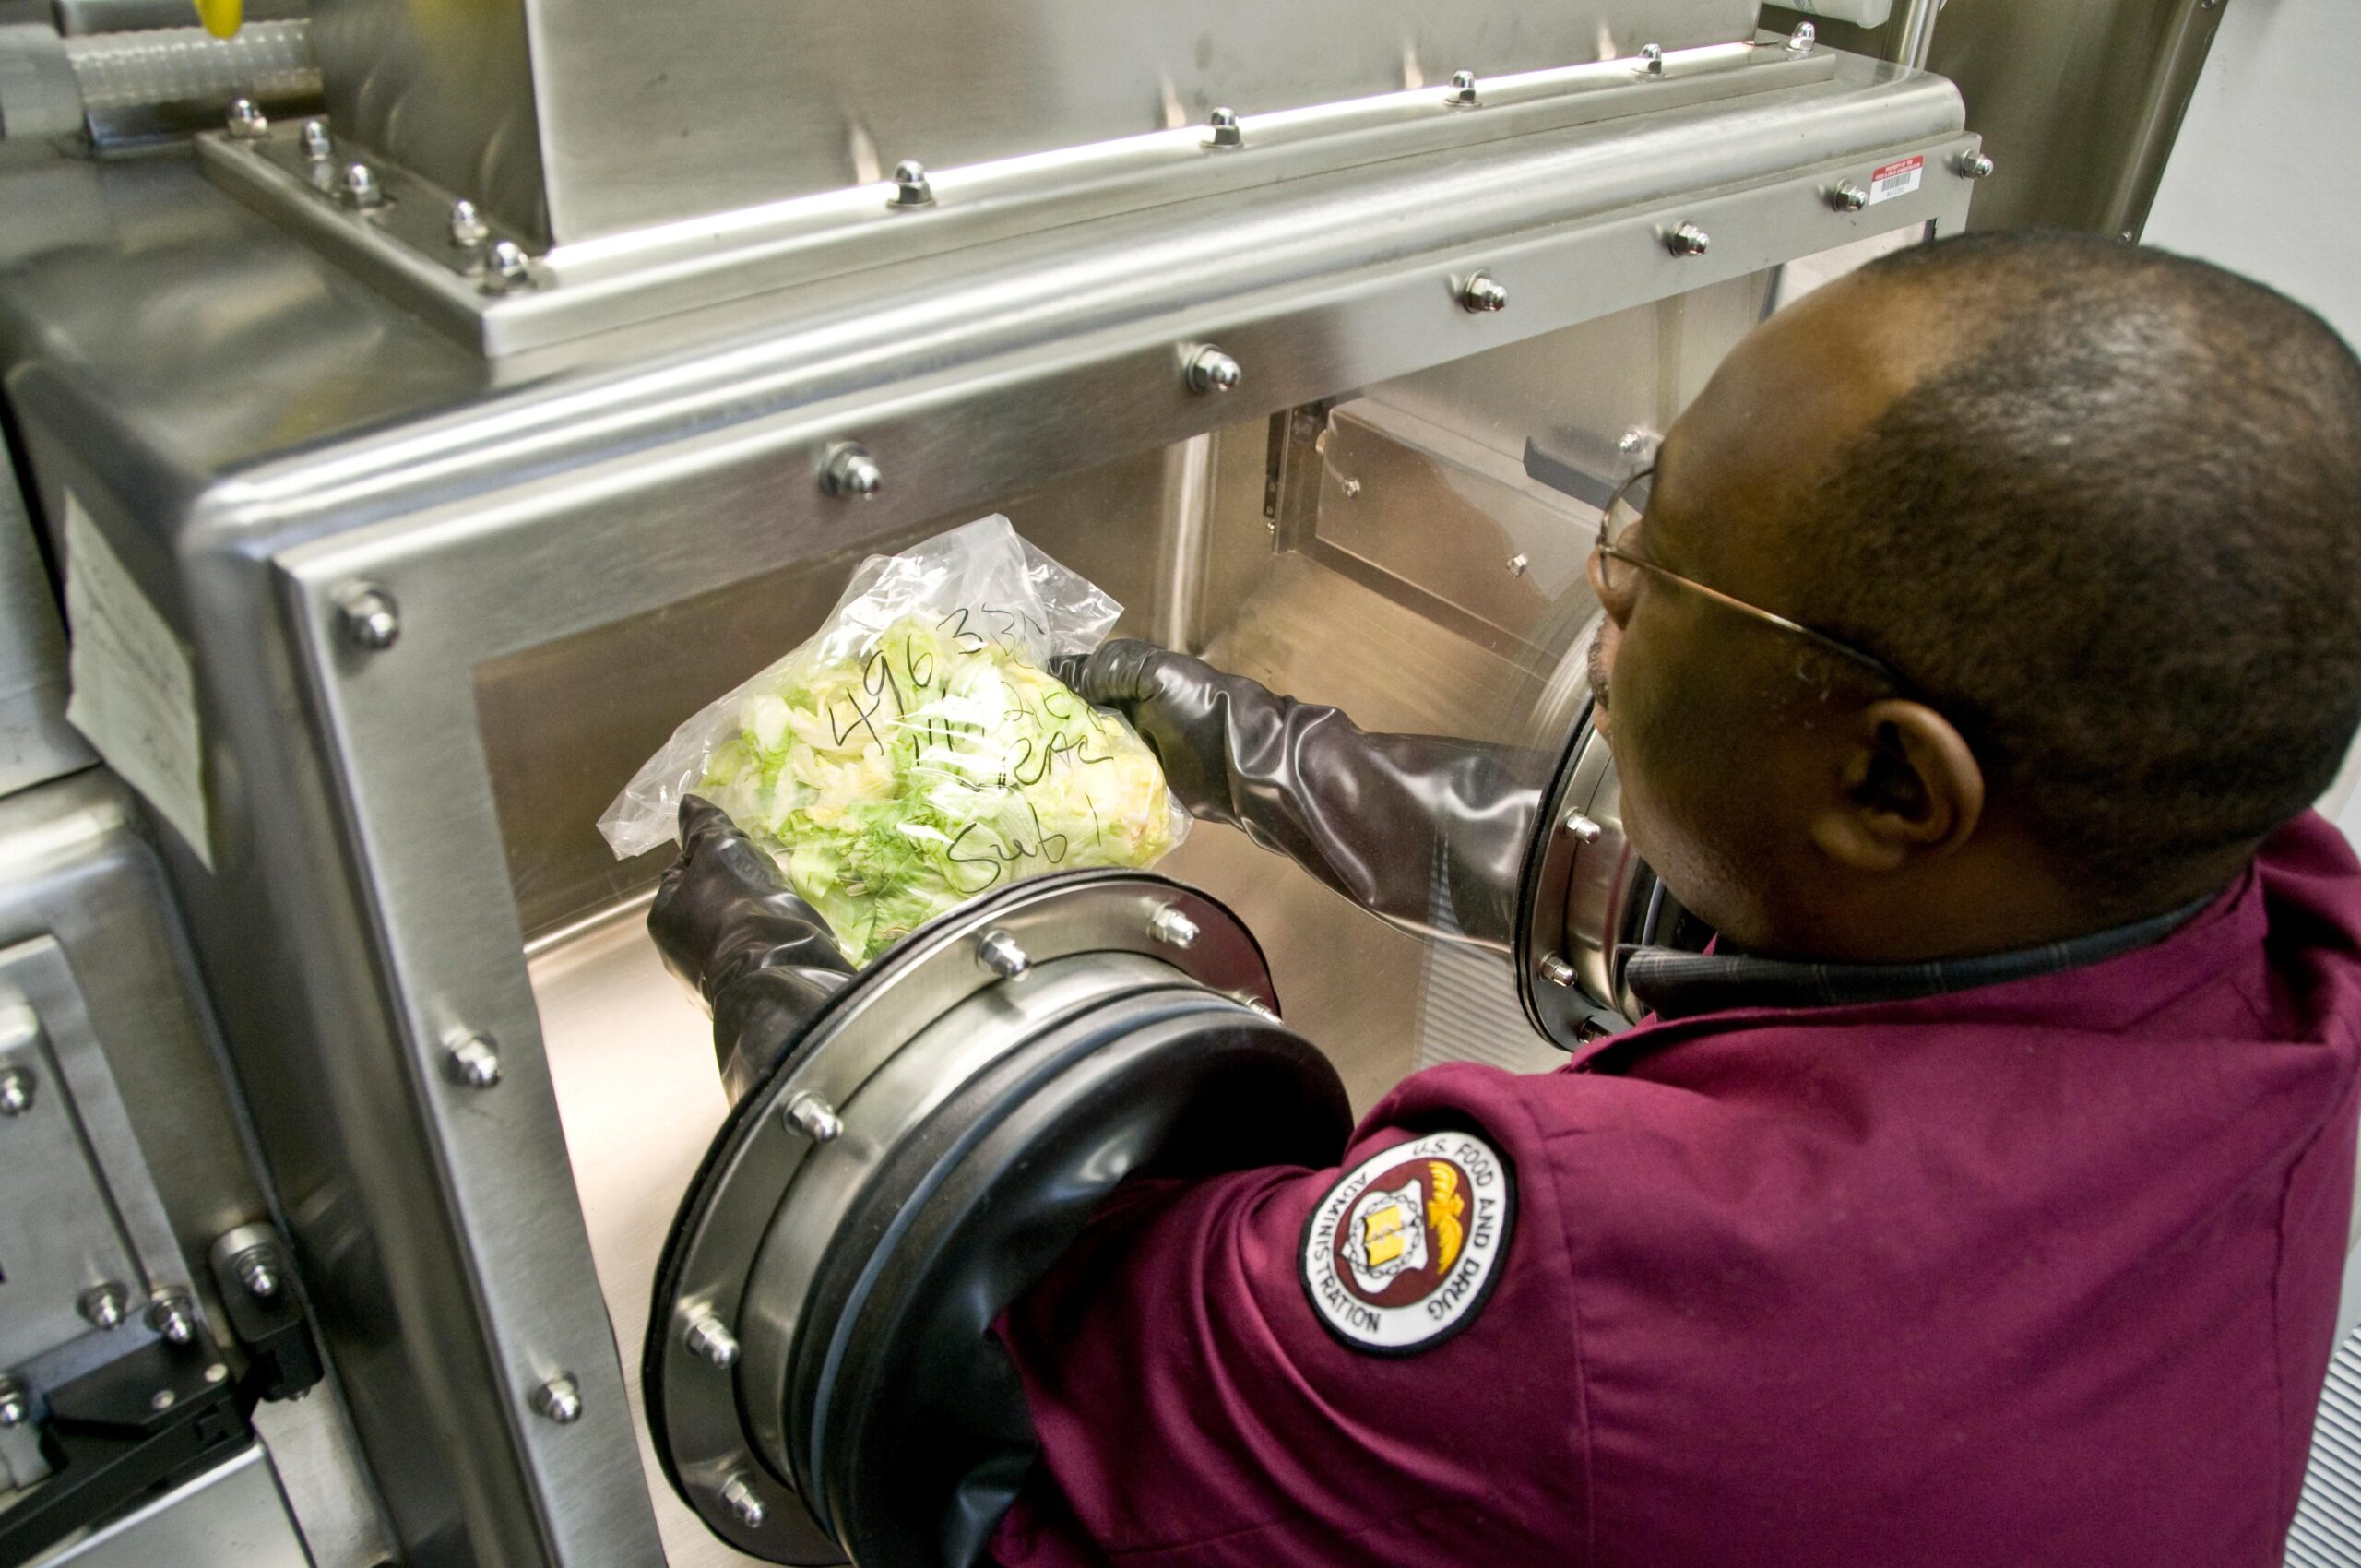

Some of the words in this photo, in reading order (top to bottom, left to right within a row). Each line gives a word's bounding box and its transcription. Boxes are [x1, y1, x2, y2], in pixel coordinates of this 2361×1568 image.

[1454, 1143, 1494, 1187] FOOD
[1473, 1198, 1495, 1249] AND
[1313, 1171, 1382, 1334] ADMINISTRATION
[1427, 1257, 1481, 1321] DRUG
